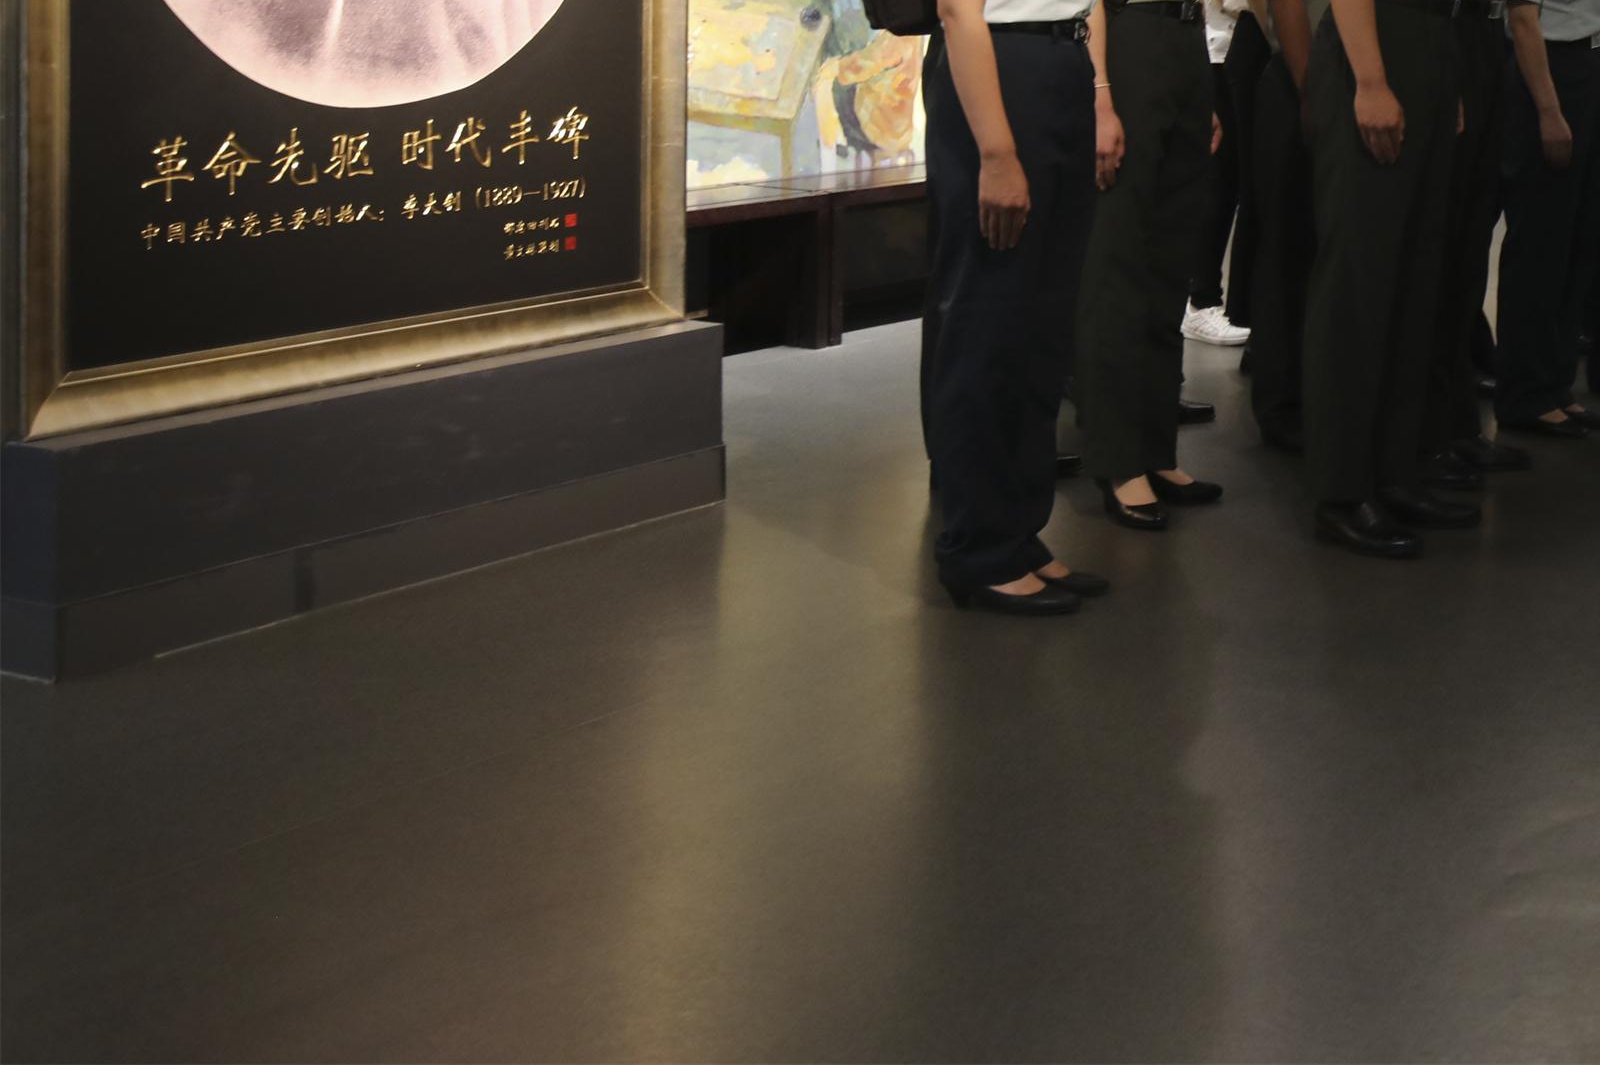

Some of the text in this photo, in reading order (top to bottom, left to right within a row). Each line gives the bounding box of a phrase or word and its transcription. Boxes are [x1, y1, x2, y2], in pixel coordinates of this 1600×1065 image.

[140, 105, 589, 203] 革命先驱 时代丰碑
